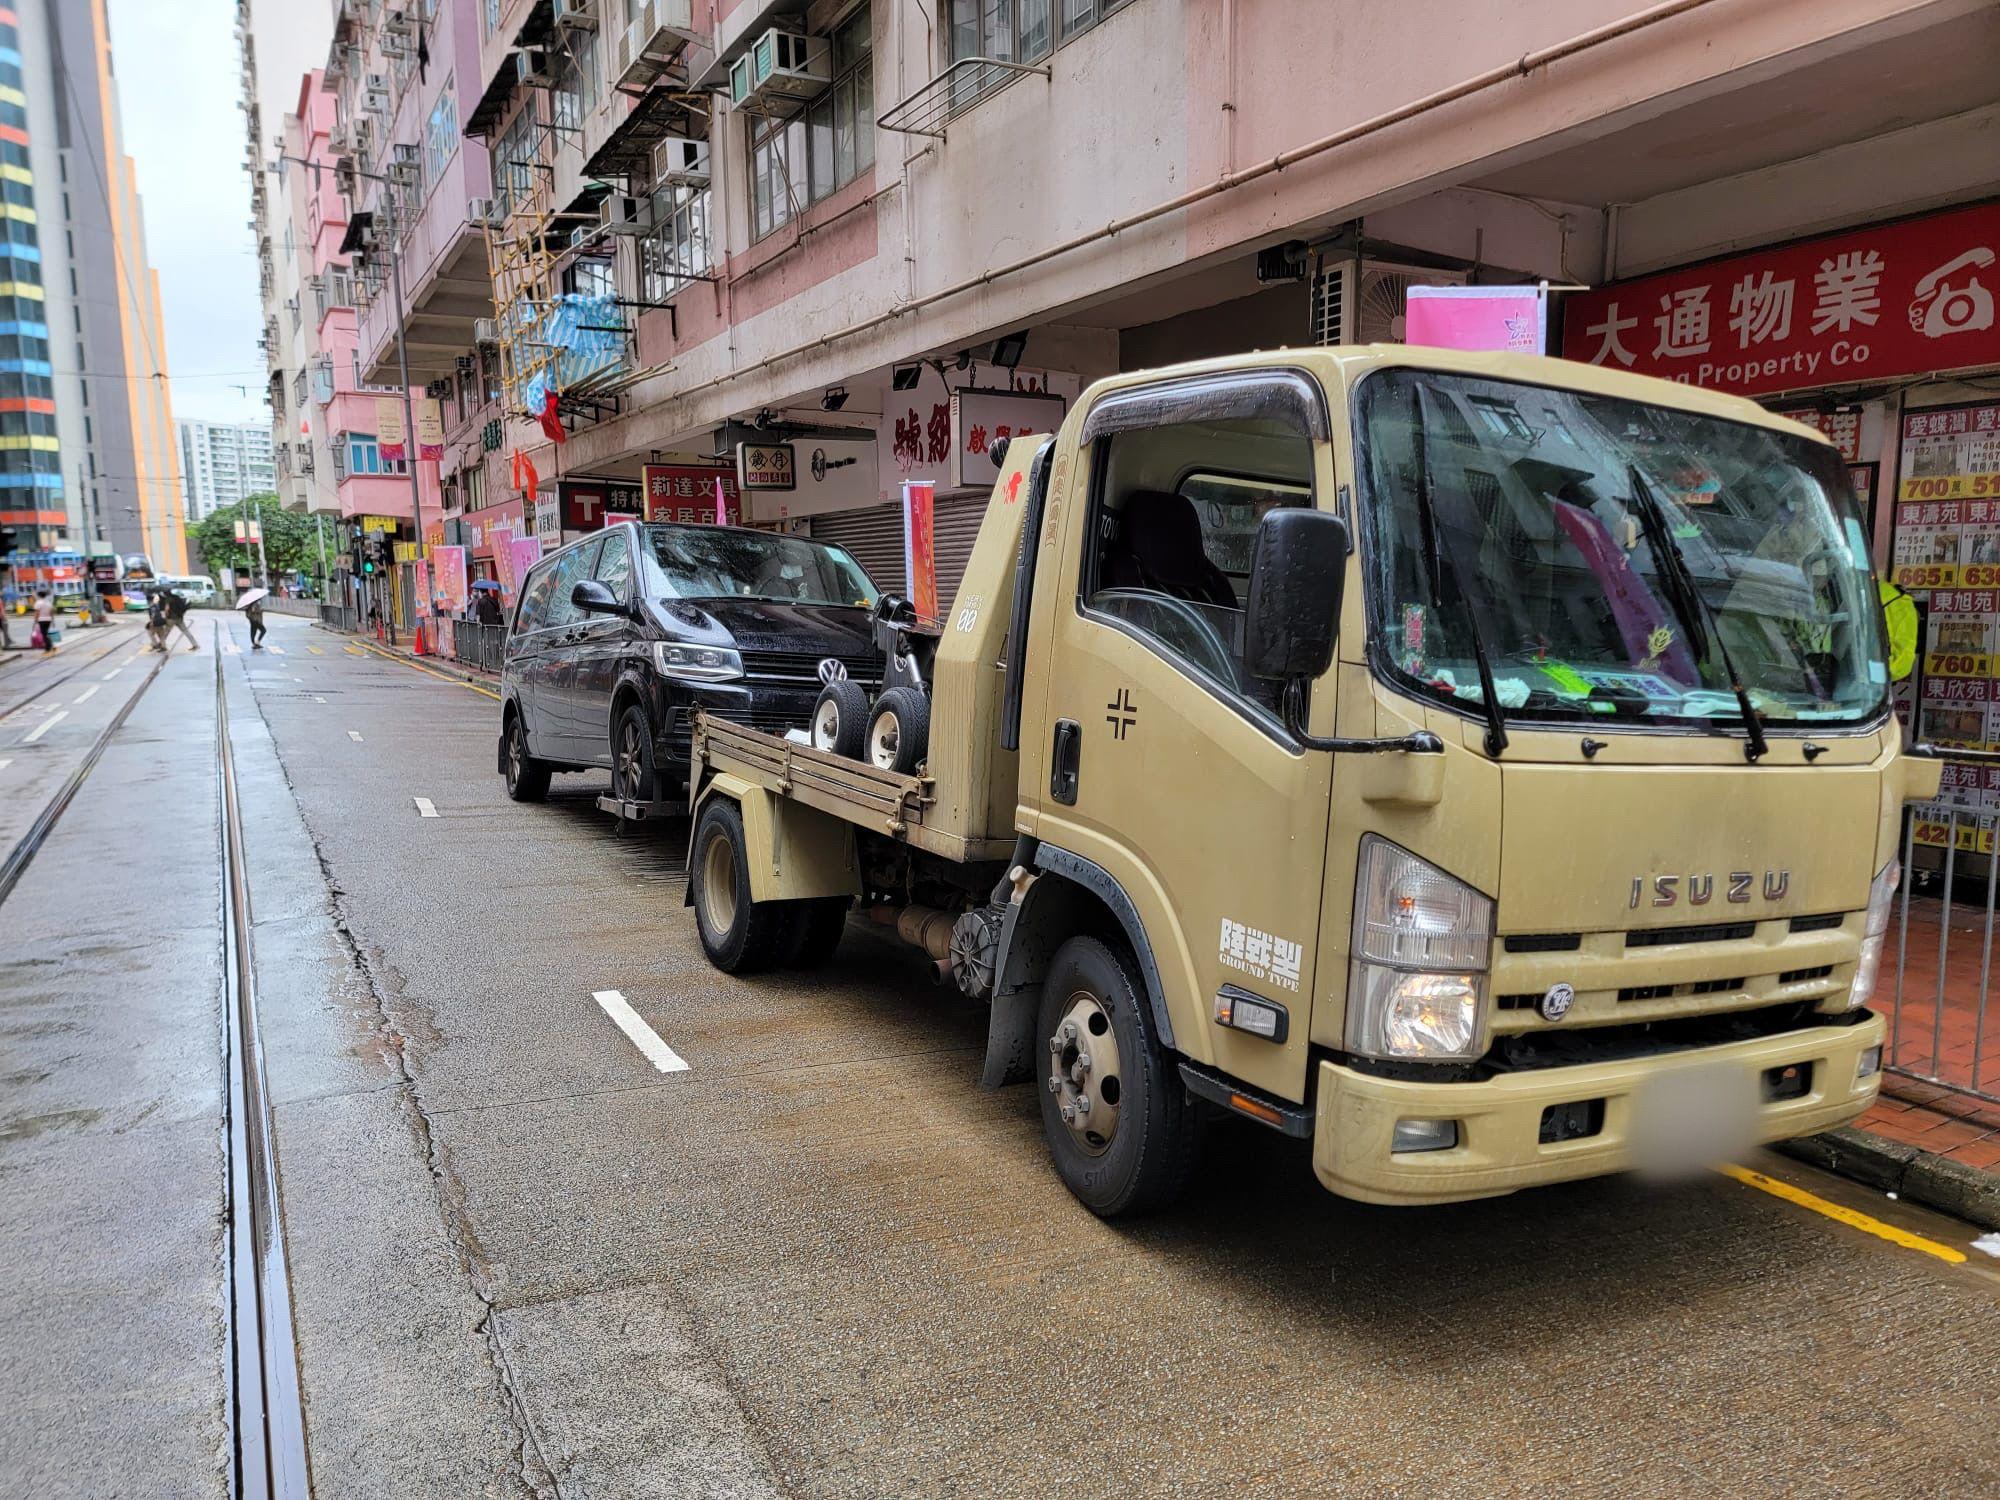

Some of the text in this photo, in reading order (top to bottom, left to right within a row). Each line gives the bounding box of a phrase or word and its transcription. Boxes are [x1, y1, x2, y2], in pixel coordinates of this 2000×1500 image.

[1584, 250, 1886, 367] 大通物業
[1698, 350, 1823, 386] Property
[1830, 341, 1870, 366] Co
[1909, 411, 1967, 437] 愛蝶灣
[1976, 406, 2000, 431] 愛
[651, 475, 738, 498] 莉達文具
[1906, 478, 1949, 498] 700
[1902, 504, 1959, 525] 東濤苑
[1898, 567, 1941, 586] 665
[1935, 591, 1994, 612] 東旭苑
[1931, 654, 1974, 673] 760
[1927, 678, 1986, 700] 東欣苑
[1941, 764, 1978, 787] 盛苑
[1629, 869, 1791, 909] ISUZU
[1219, 952, 1300, 993] GROUND TYPE
